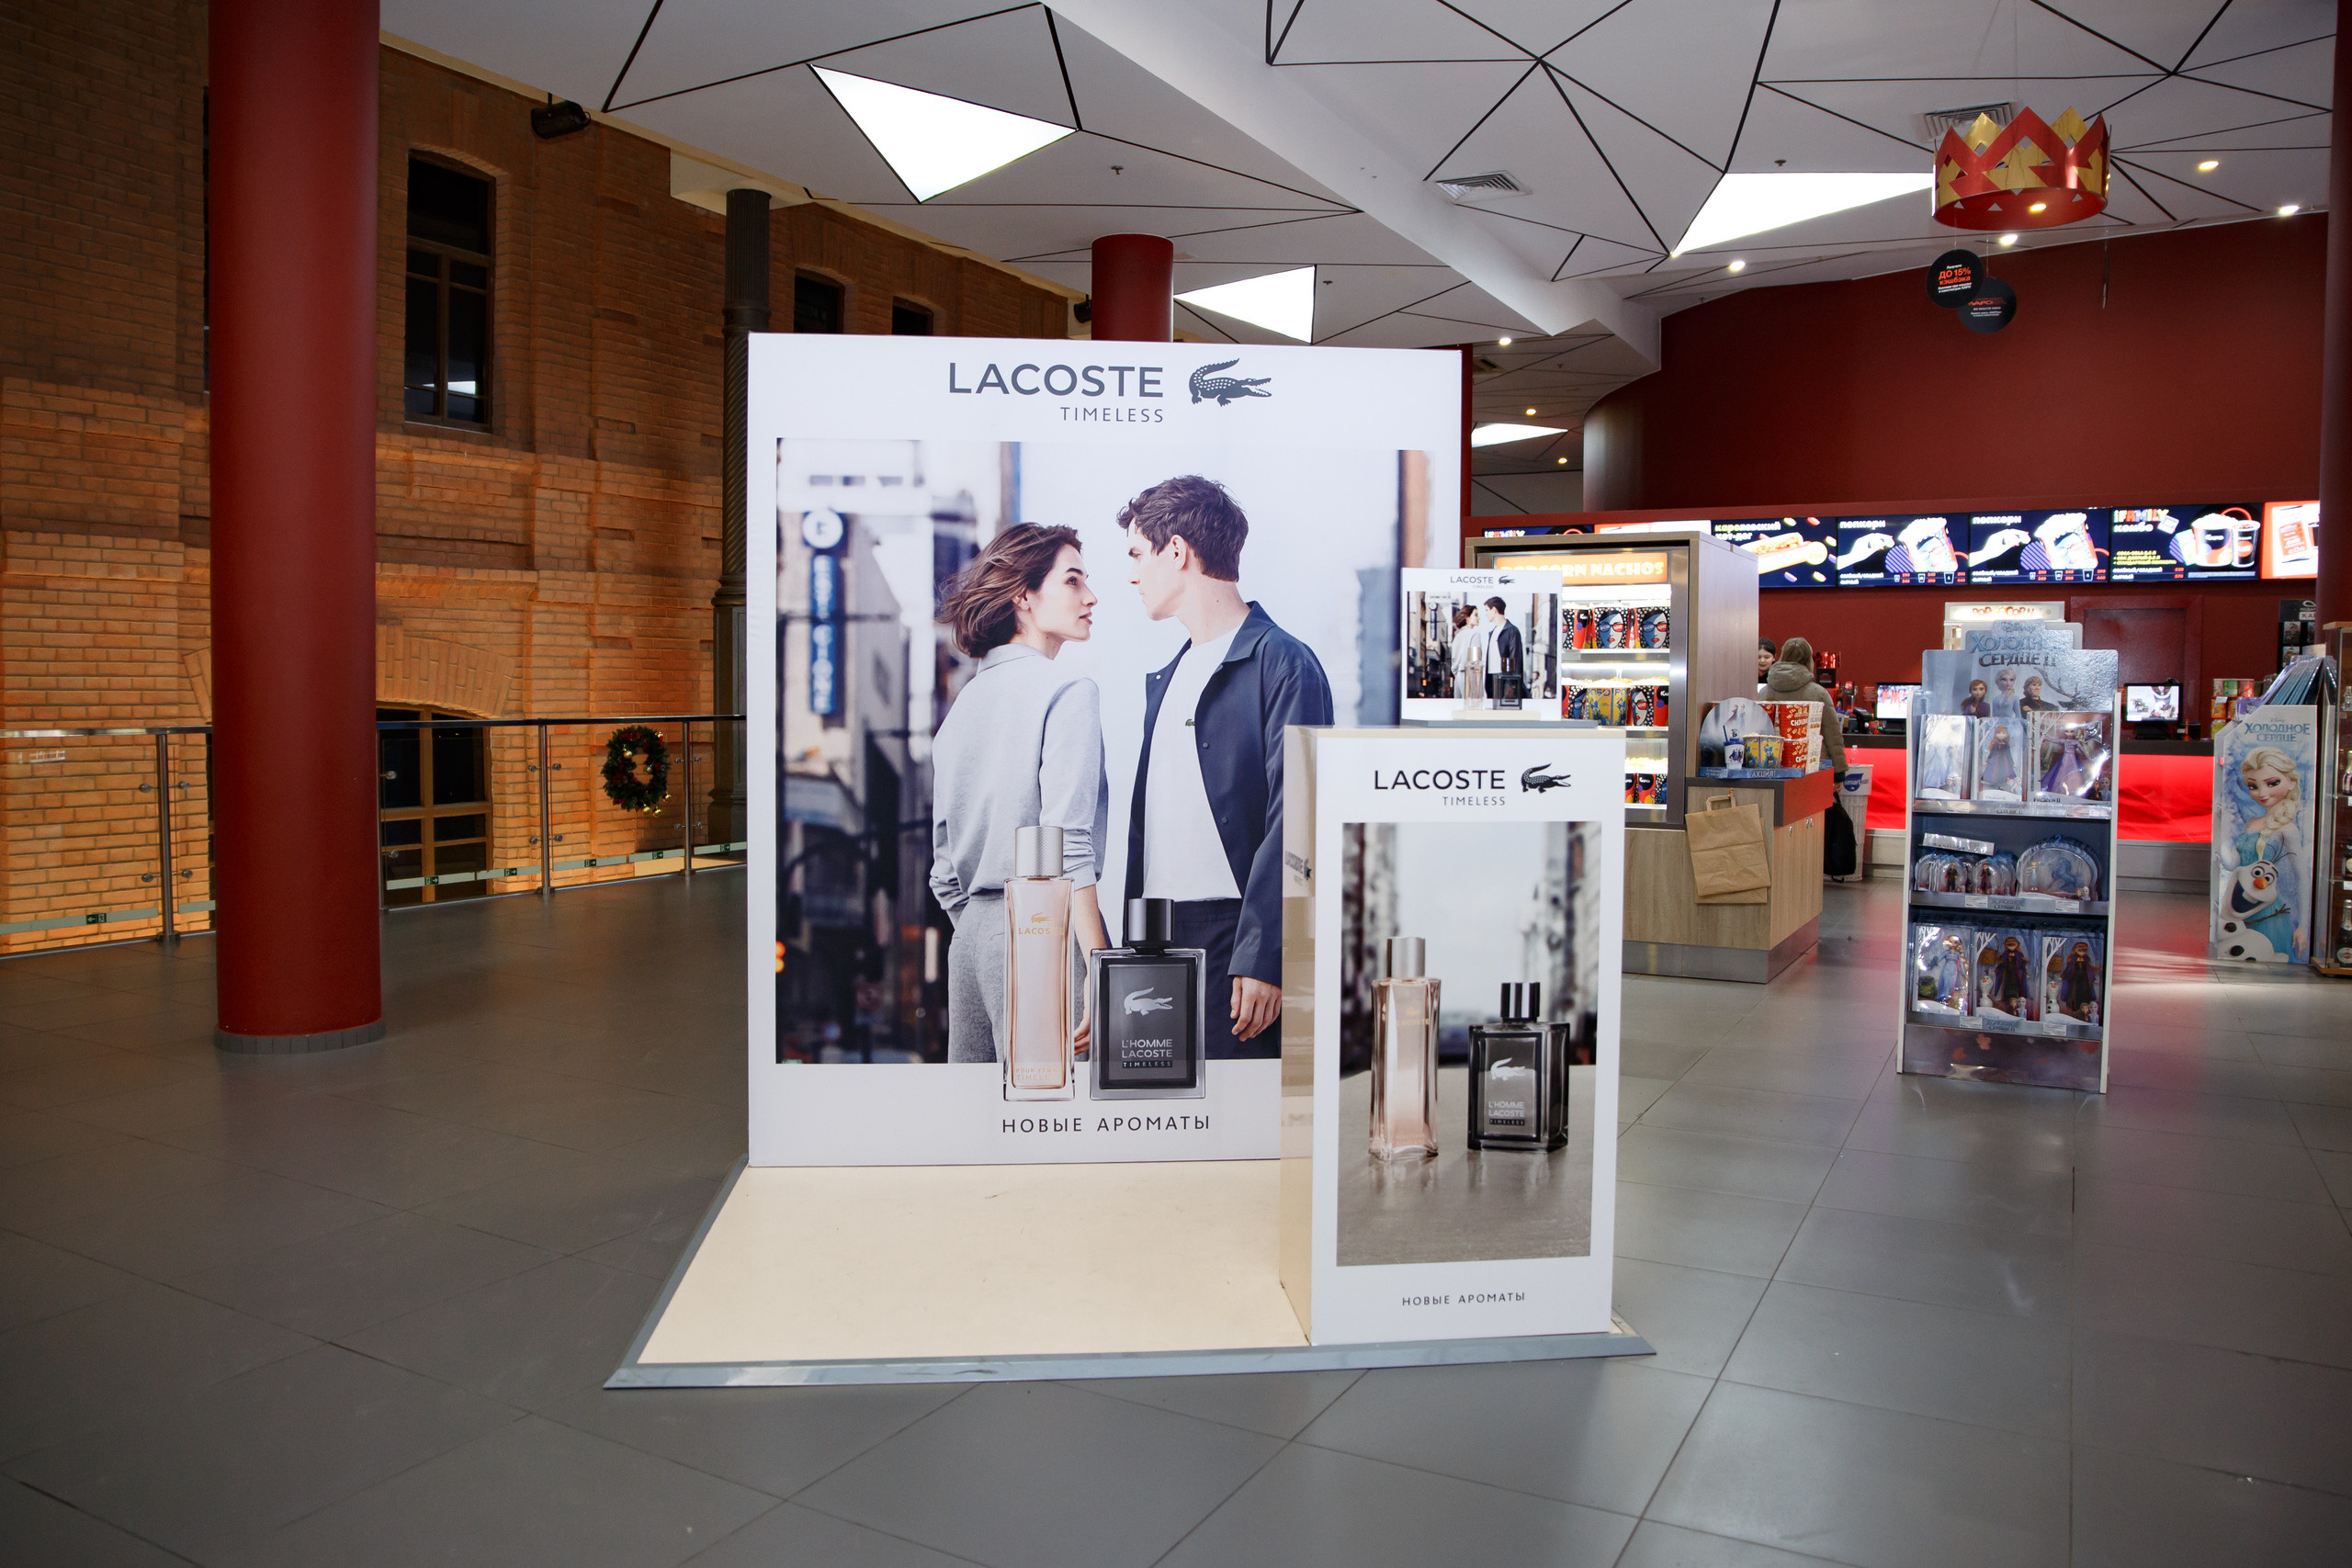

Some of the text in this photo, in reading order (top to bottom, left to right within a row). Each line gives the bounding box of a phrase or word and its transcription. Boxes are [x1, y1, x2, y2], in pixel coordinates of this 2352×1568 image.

[1939, 266, 1972, 280] ДО 15%
[1939, 276, 1971, 285] кэшбэка
[949, 362, 1164, 398] LACOSTE
[1060, 406, 1164, 423] TIMELESS
[1972, 514, 2022, 527] попкорн
[2119, 508, 2170, 523] FAMILY
[1714, 521, 1781, 534] каролевский
[1839, 520, 1886, 531] попкорн
[1589, 561, 1665, 576] NACHOS
[1450, 575, 1494, 584] LACOSTE
[1972, 605, 2035, 616] POP CORN
[1969, 633, 2062, 654] ХОЛОДН
[1978, 652, 2041, 668] СЕРДЦЕ
[2245, 723, 2312, 736] ХОЛОДНОЕ
[2256, 733, 2298, 743] СЕРДЦЕ
[1374, 769, 1506, 790] LACOSTE
[1442, 795, 1506, 807] TIMELESS
[1121, 1038, 1173, 1049] L'HOMME
[1121, 1049, 1173, 1059] LACOSTE
[1487, 1100, 1525, 1110] L'HOMME
[1487, 1109, 1525, 1118] LACOSTE
[1001, 1115, 1210, 1134] НОВЫЕ АРОМАТЫ
[1402, 1292, 1525, 1306] НОВЫЕ АРОМАТЫ
